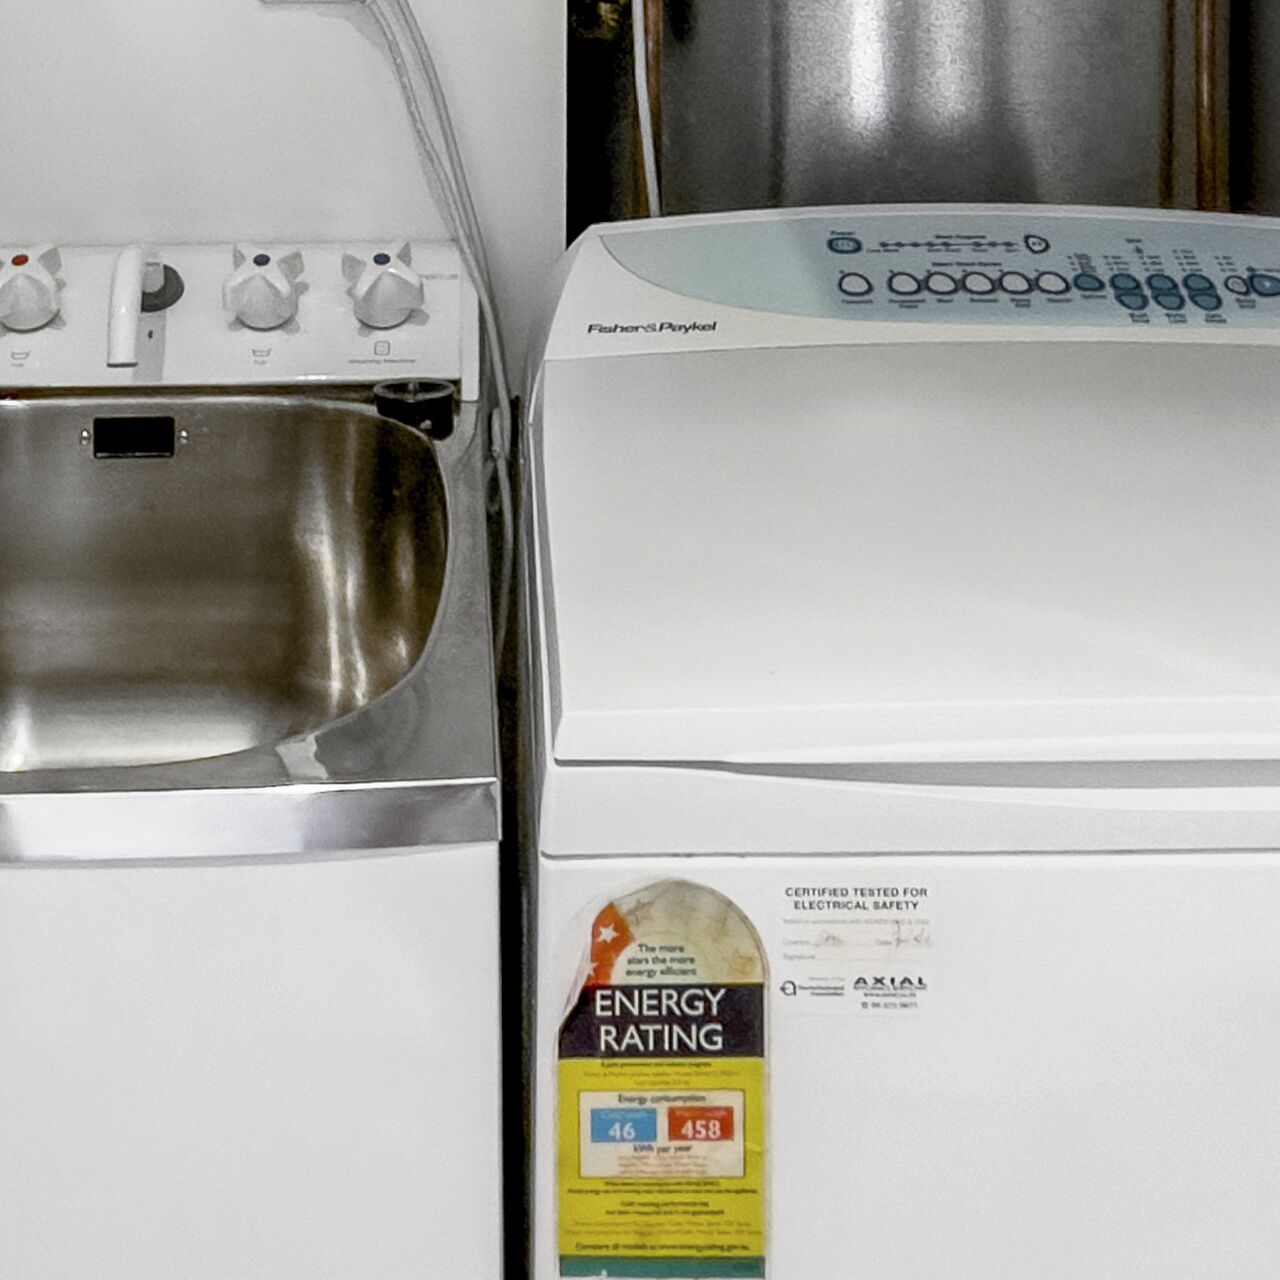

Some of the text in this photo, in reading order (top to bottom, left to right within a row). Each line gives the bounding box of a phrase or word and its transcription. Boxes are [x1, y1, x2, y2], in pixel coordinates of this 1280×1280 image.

[784, 886, 928, 898] CERTIFIED TESTED FOR
[793, 900, 919, 910] ELECTRICAL SAFETY
[638, 943, 656, 952] The
[651, 955, 667, 964] the
[669, 957, 695, 965] more
[625, 968, 657, 978] energy
[853, 976, 928, 990] AXIAL
[594, 988, 727, 1017] ENERGY
[599, 1023, 724, 1052] RATING
[618, 1094, 706, 1105] Energy consumption
[608, 1121, 637, 1141] 46
[680, 1120, 721, 1140] 458
[656, 1146, 671, 1155] per
[674, 1145, 693, 1154] year
